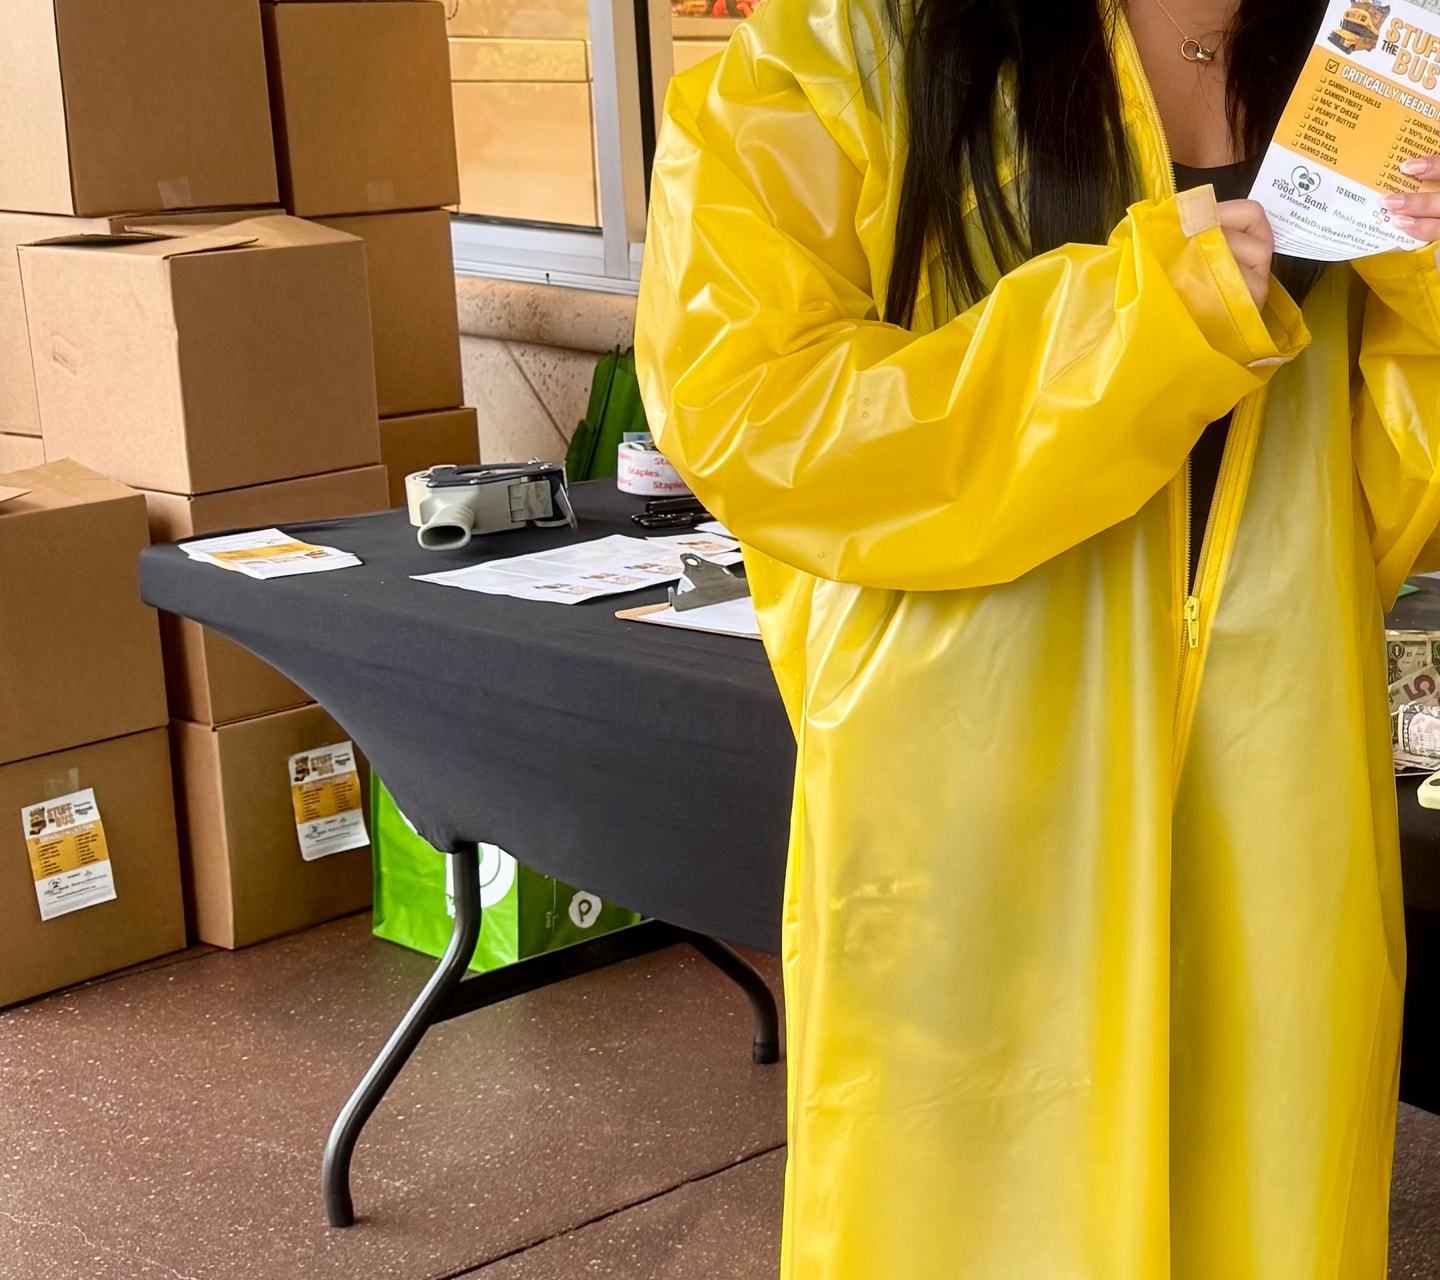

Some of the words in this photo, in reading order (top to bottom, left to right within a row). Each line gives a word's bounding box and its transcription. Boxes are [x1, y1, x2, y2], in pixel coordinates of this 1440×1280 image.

[1381, 40, 1399, 57] THE
[1391, 50, 1440, 91] BUS
[1341, 65, 1399, 102] CRITICALLY
[1398, 93, 1436, 118] NEEDED
[1272, 179, 1295, 195] Food
[1304, 195, 1328, 213] Bank
[1402, 674, 1436, 701] 5
